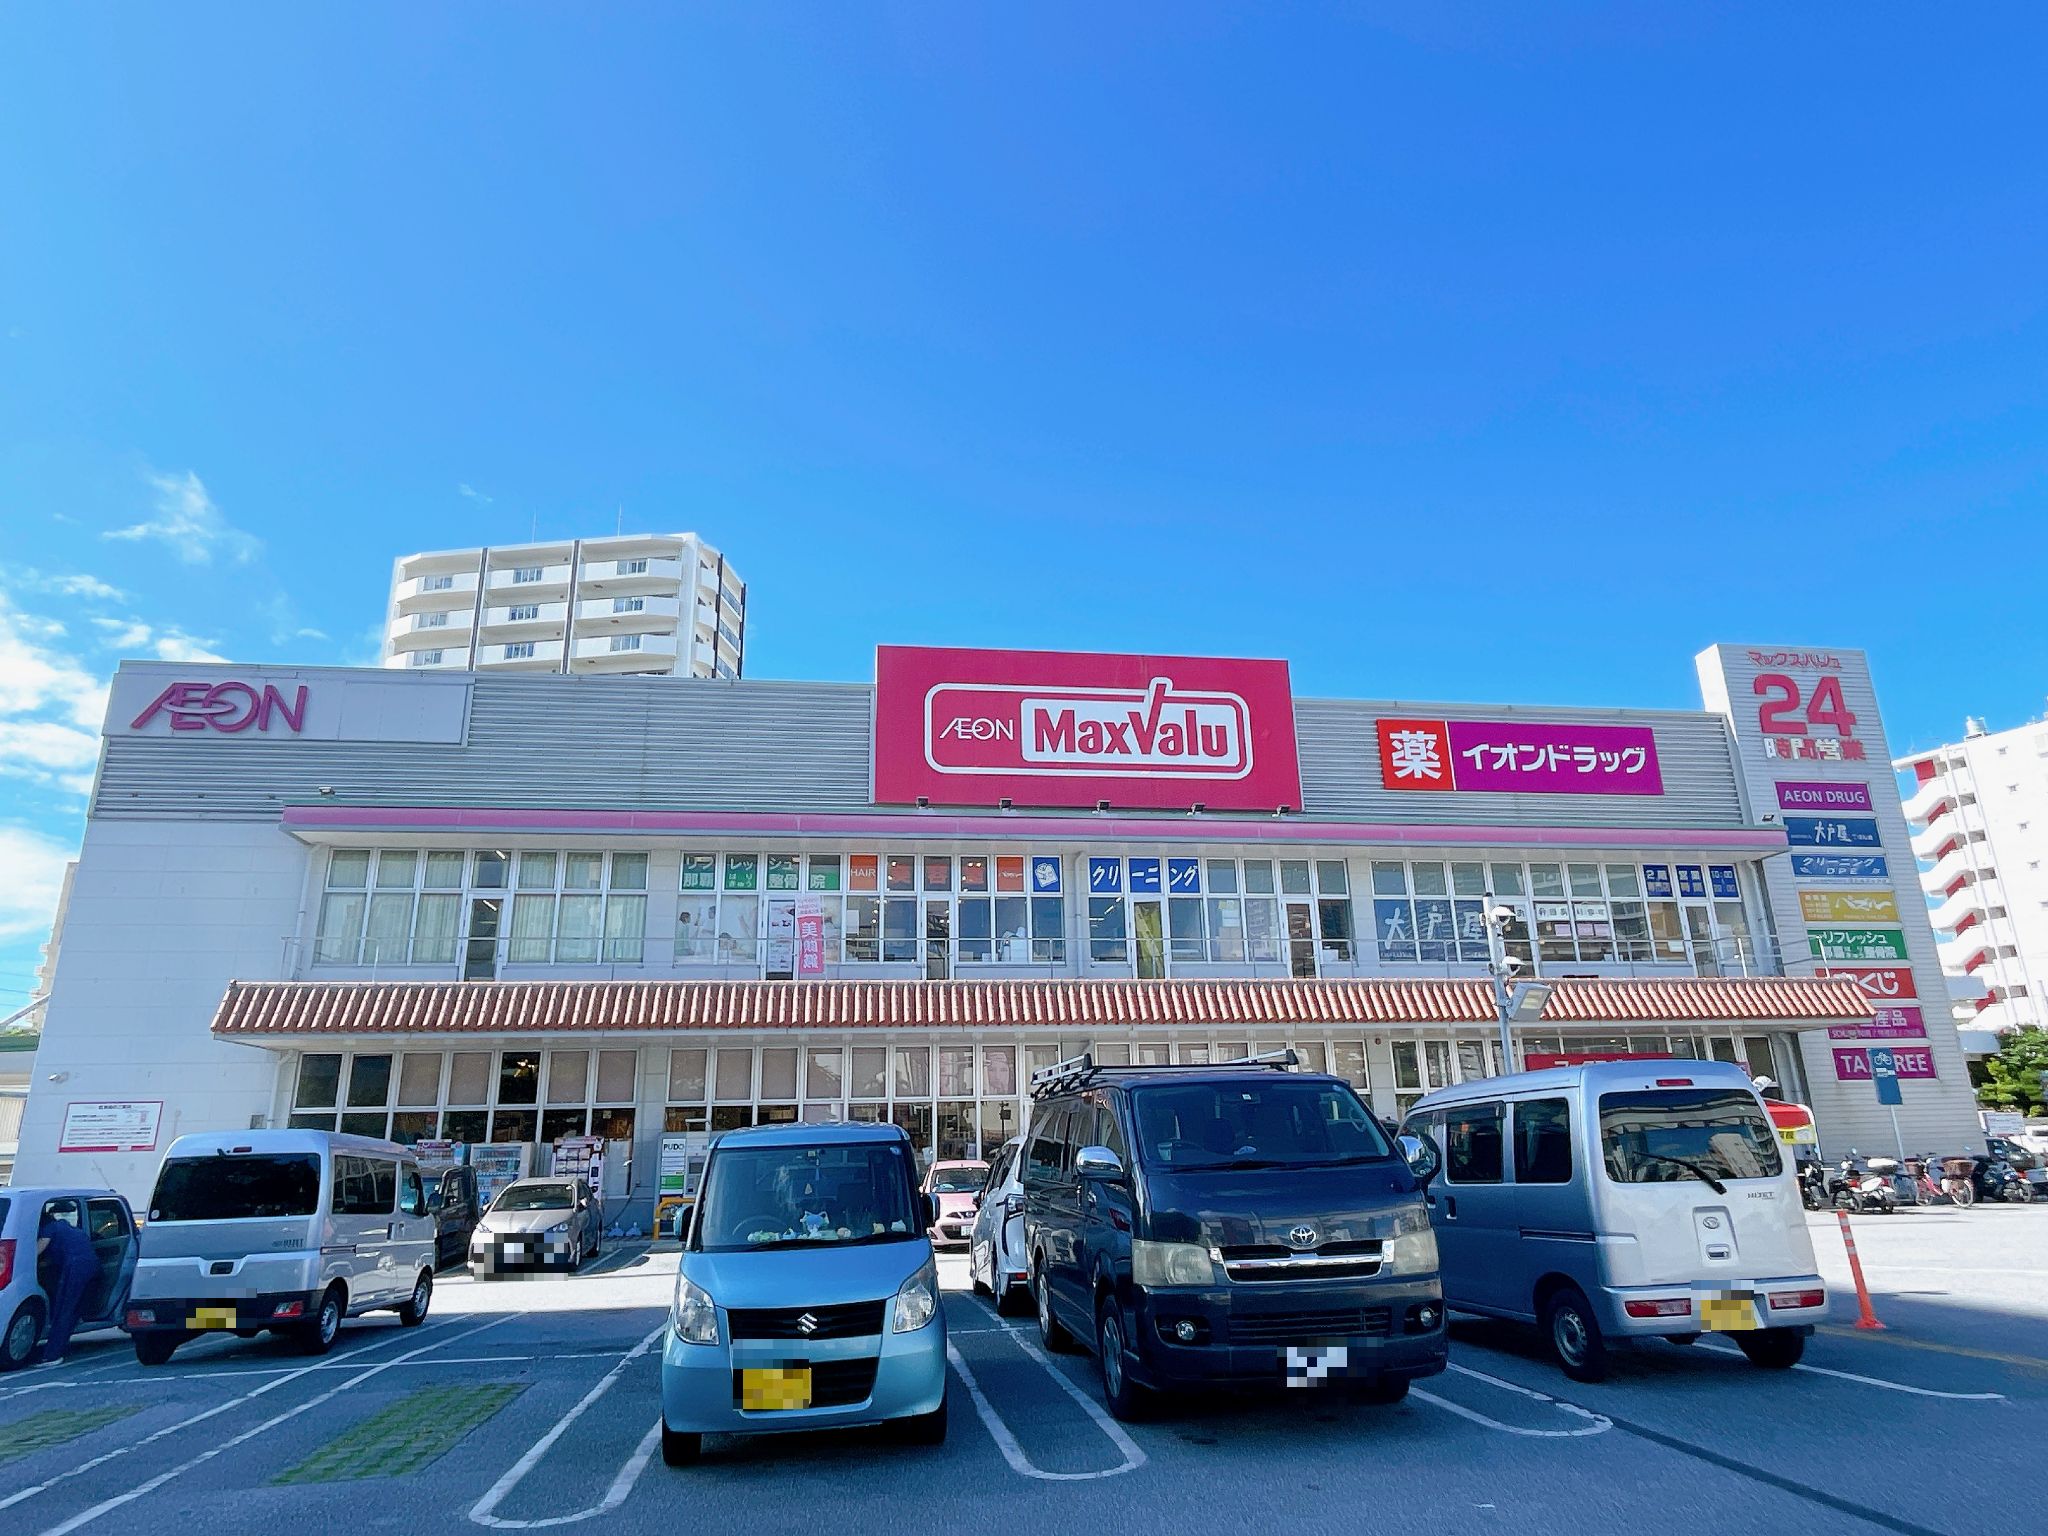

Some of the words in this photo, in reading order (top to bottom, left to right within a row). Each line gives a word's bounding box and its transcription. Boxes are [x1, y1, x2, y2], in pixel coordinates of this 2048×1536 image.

[131, 682, 308, 732] AEON
[1753, 673, 1857, 737] 24
[939, 717, 1014, 741] AEON
[1034, 683, 1229, 758] MaxValu
[1389, 730, 1443, 780] 薬
[1462, 743, 1646, 774] イオンドラッグ
[1763, 738, 1867, 760] 時間営業
[1784, 790, 1822, 803] AEON
[1825, 791, 1865, 804] DRUG
[850, 868, 876, 877] HAIR
[1802, 857, 1875, 868] クリーニング
[1092, 865, 1198, 887] クリーニング
[1822, 931, 1888, 944] リフレッシュ
[1840, 1055, 1872, 1073] TA
[1893, 1053, 1929, 1072] REE
